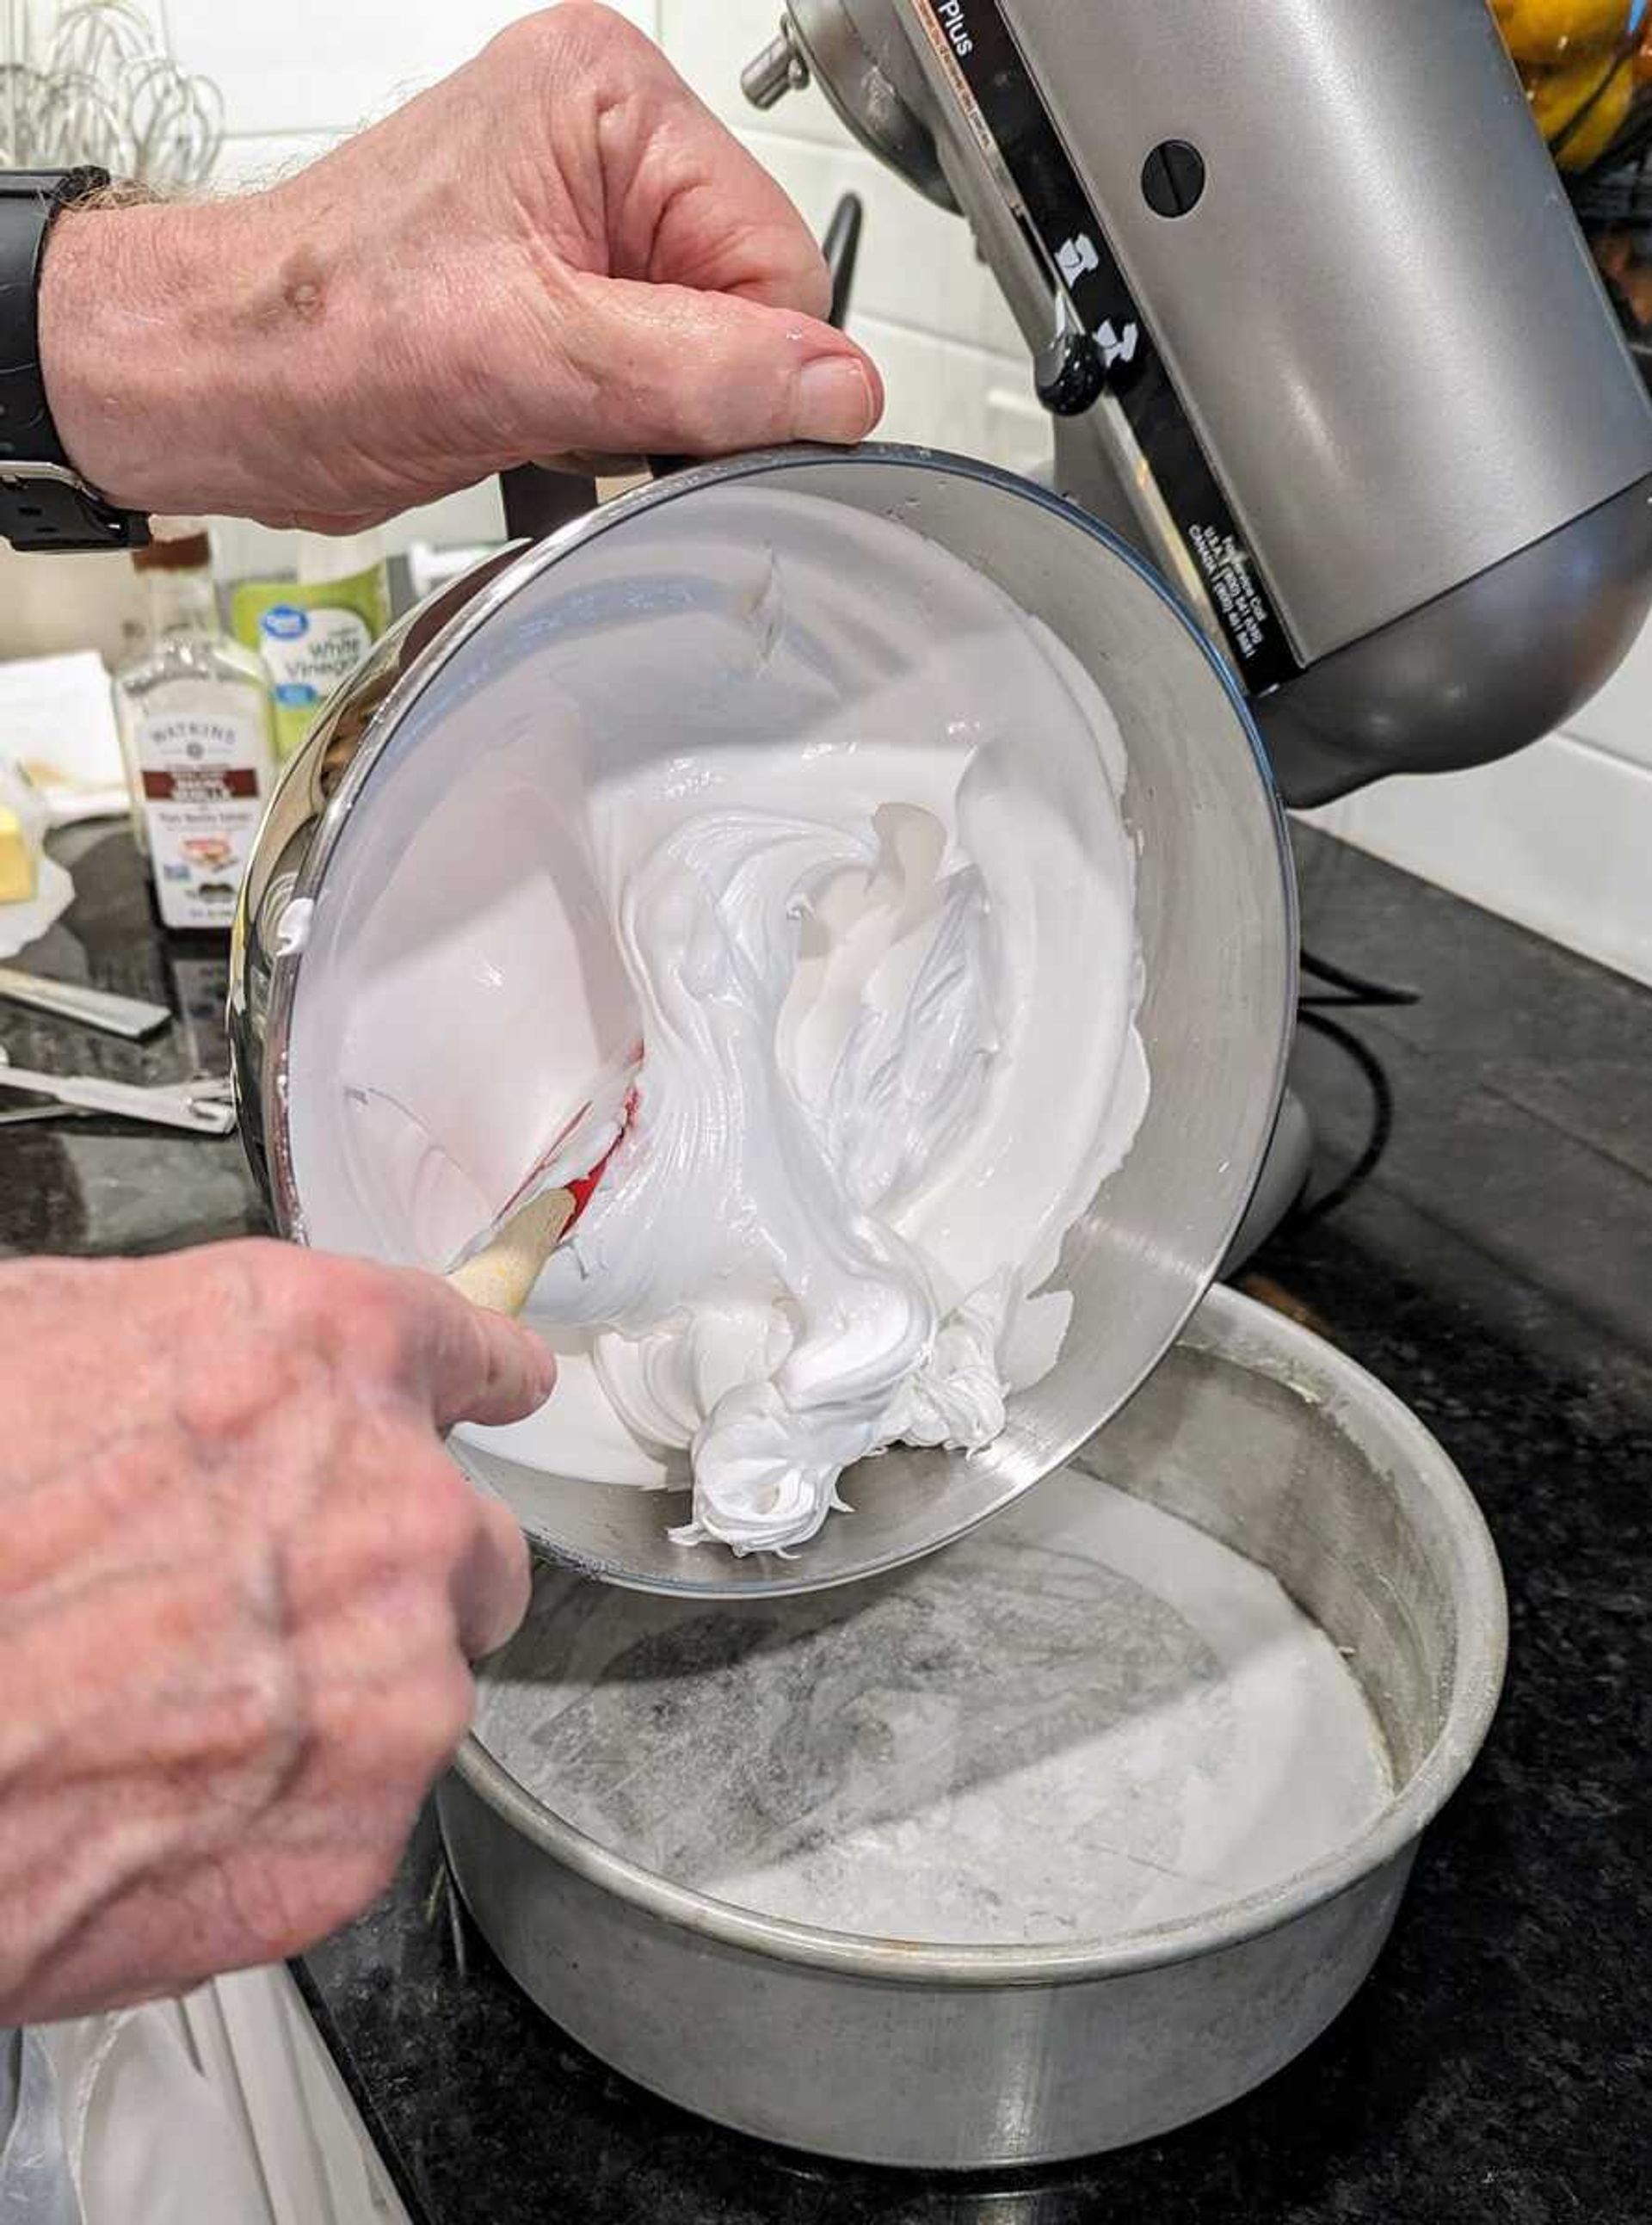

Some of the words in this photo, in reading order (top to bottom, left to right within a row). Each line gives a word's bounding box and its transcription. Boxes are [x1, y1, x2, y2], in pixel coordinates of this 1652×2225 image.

[938, 0, 973, 56] Plus
[309, 638, 360, 656] White
[151, 722, 236, 745] WATKINS
